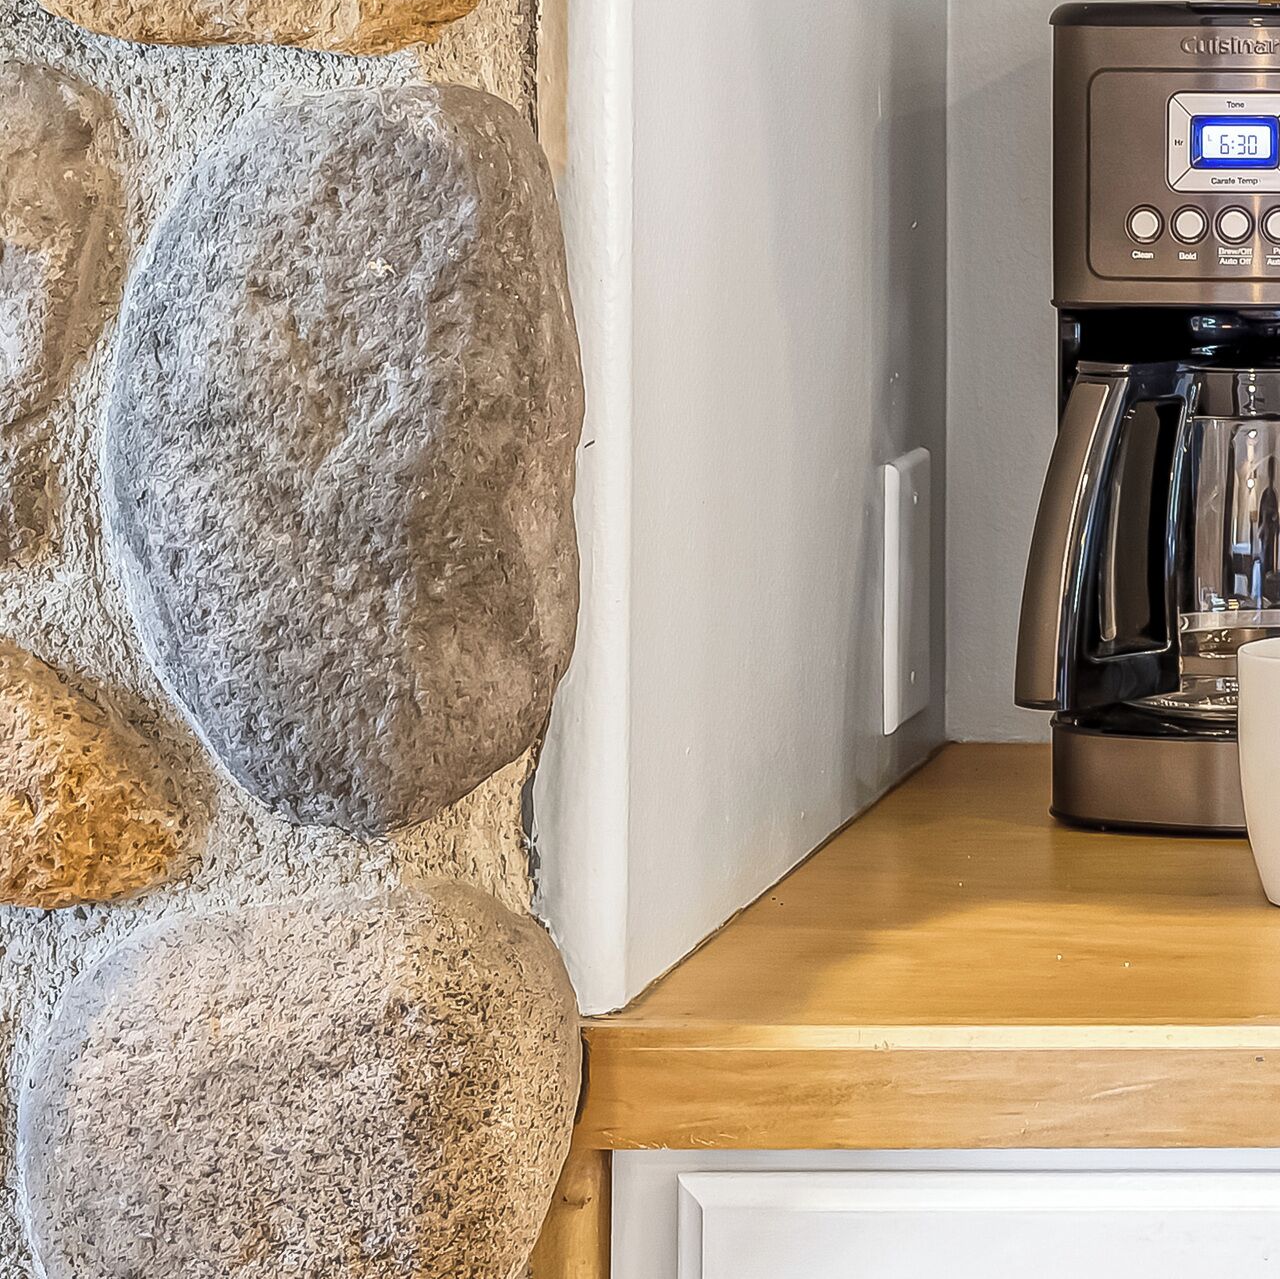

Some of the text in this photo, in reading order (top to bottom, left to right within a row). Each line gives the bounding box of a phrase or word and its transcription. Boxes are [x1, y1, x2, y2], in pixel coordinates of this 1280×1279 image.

[1220, 134, 1258, 155] 6:30
[1219, 257, 1252, 265] Auto Off
